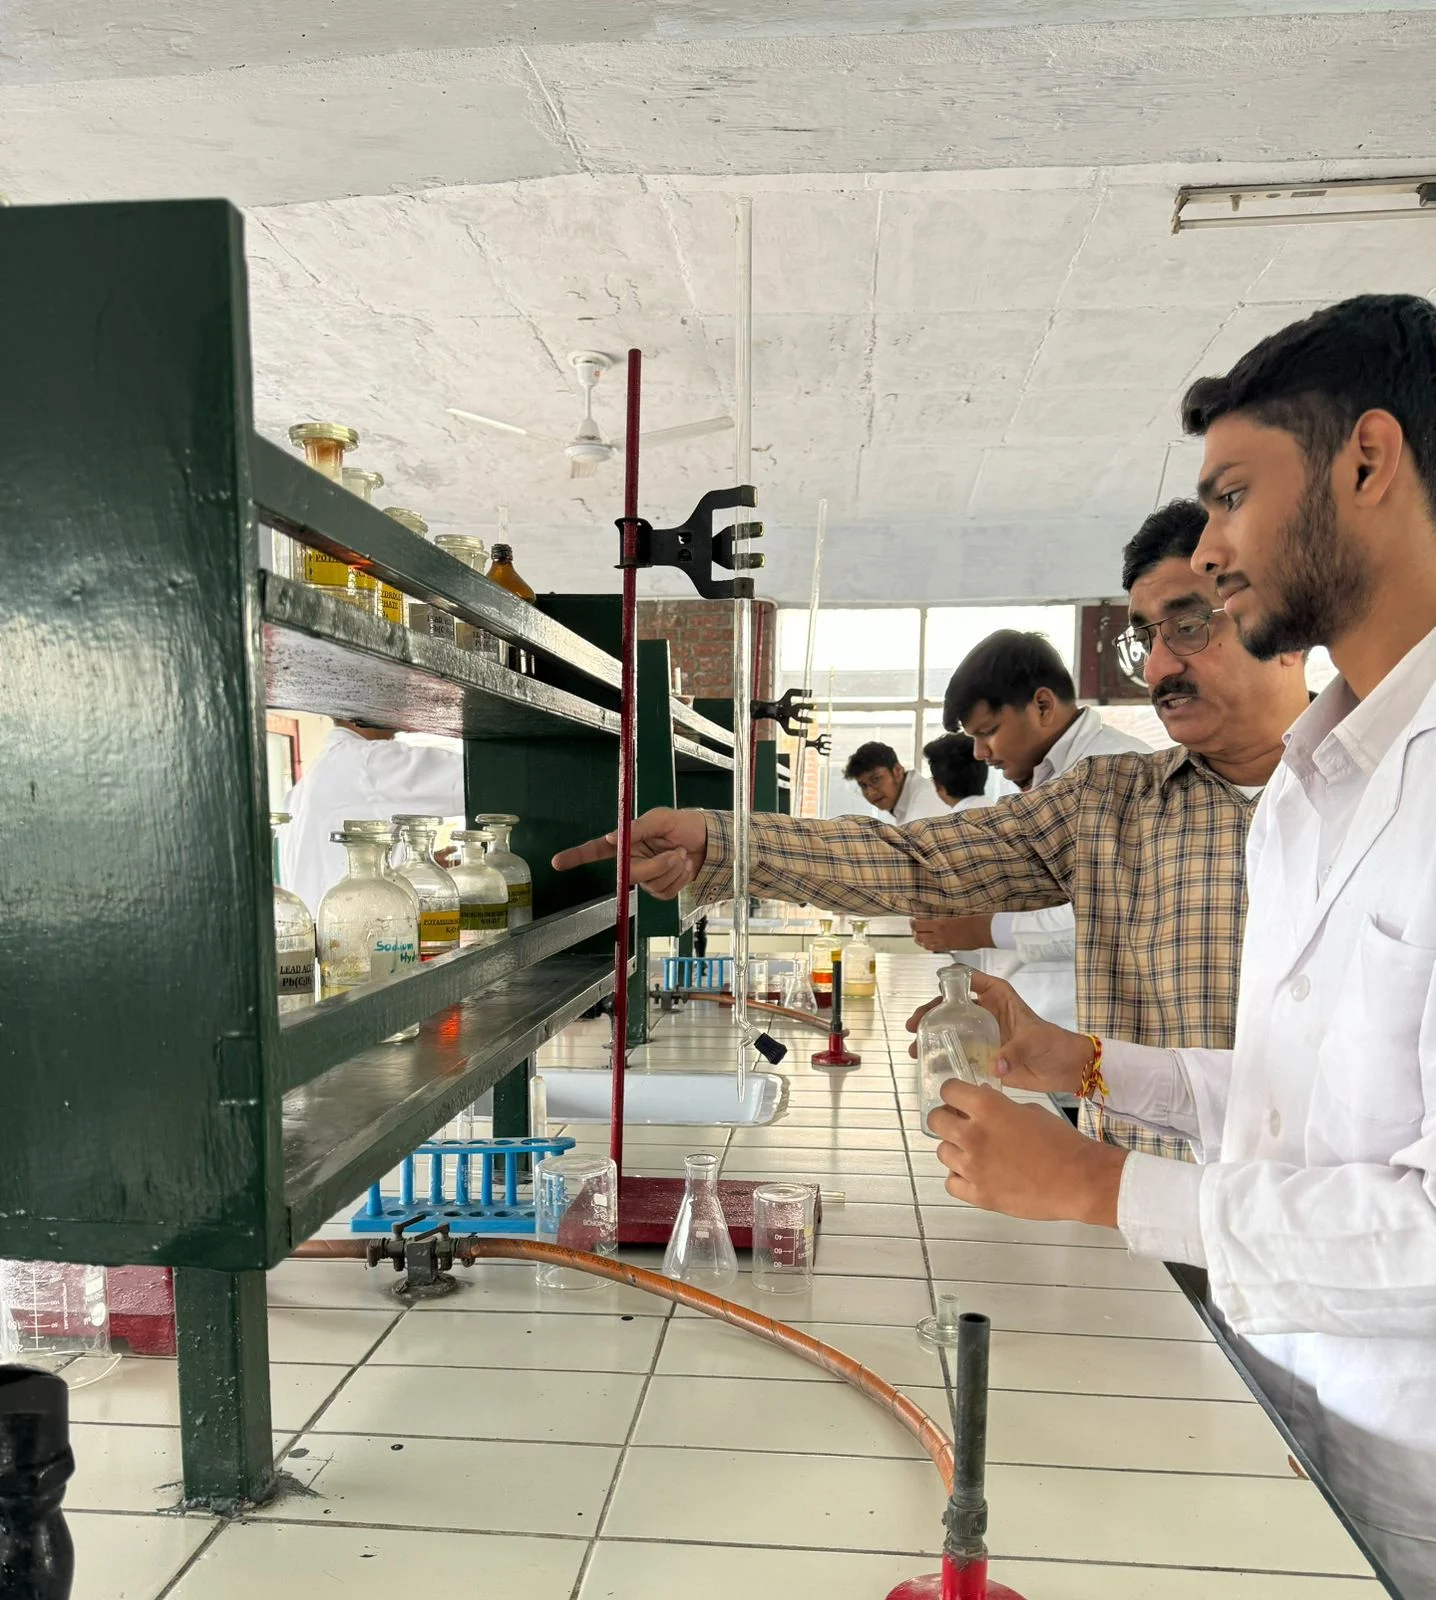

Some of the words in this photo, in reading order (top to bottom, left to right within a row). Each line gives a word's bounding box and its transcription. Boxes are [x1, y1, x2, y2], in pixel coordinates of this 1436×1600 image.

[374, 940, 414, 952] Sodium
[280, 965, 301, 974] LEAD
[7, 1320, 21, 1329] 150
[9, 1343, 23, 1353] 200
